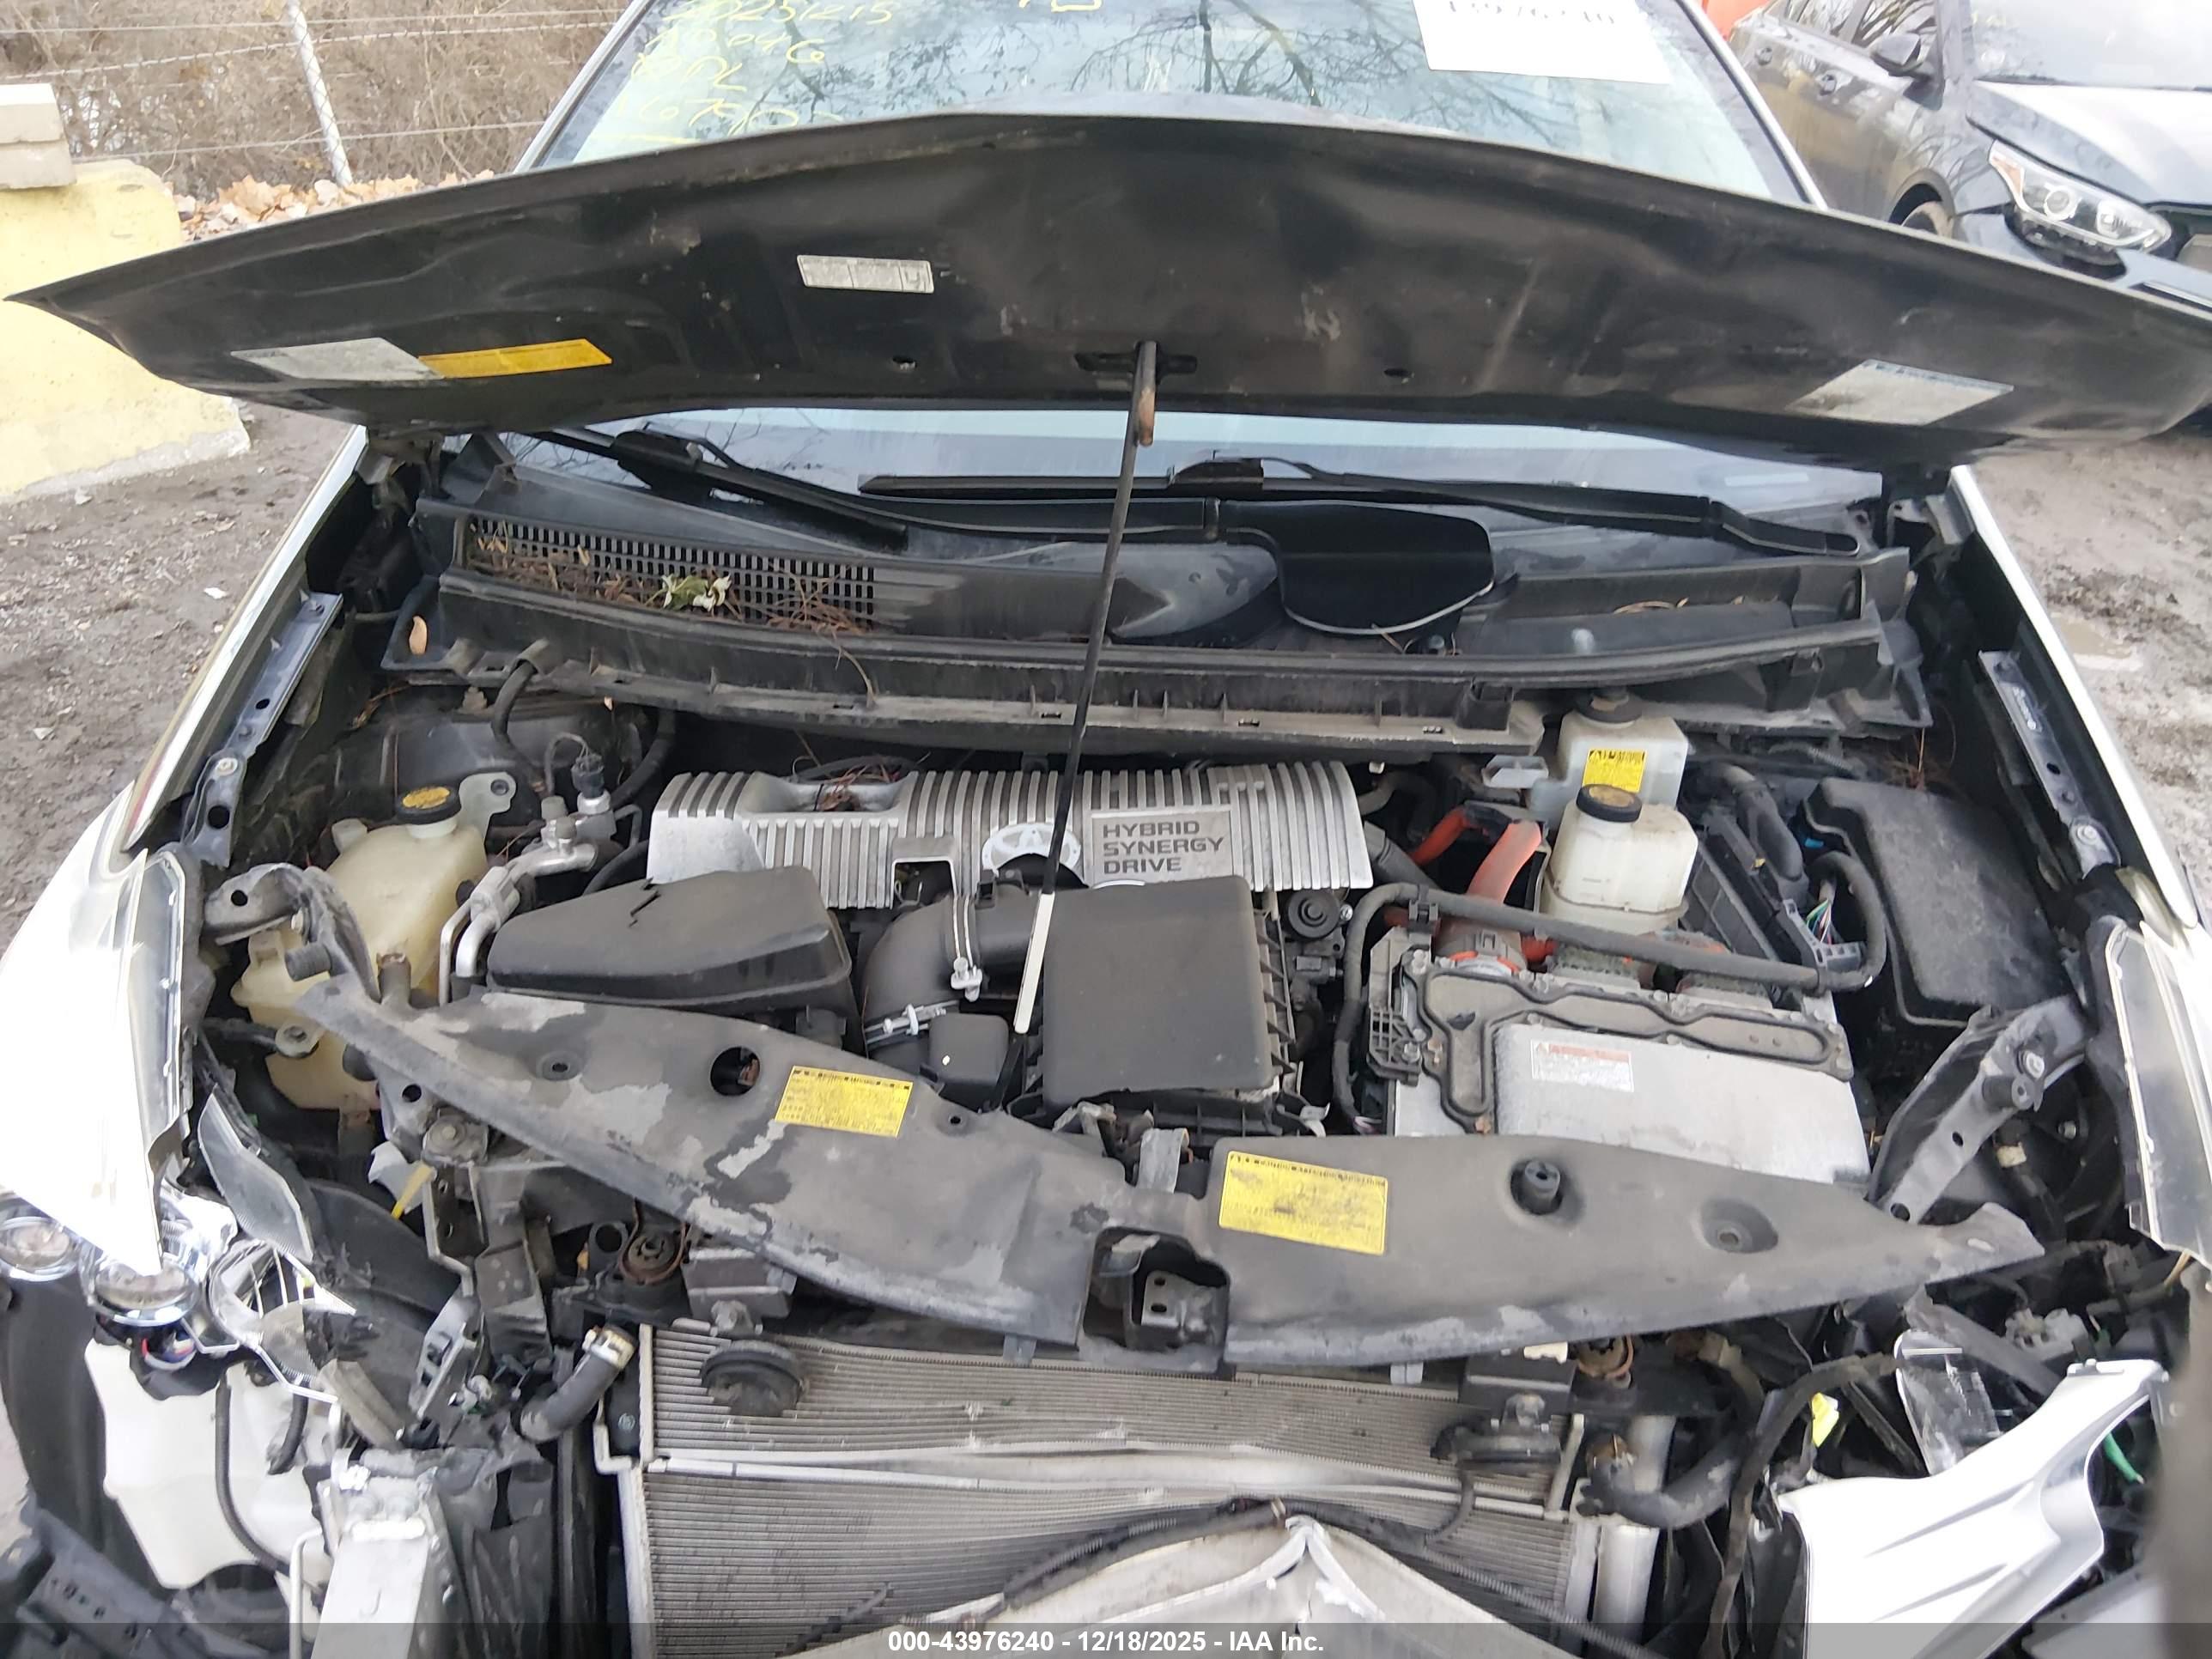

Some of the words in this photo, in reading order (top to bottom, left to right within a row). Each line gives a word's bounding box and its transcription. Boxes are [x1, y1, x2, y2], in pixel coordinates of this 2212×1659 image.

[1103, 821, 1200, 838] HYBRID
[1103, 837, 1224, 856] SYNERGY
[1103, 857, 1182, 874] DRIVE
